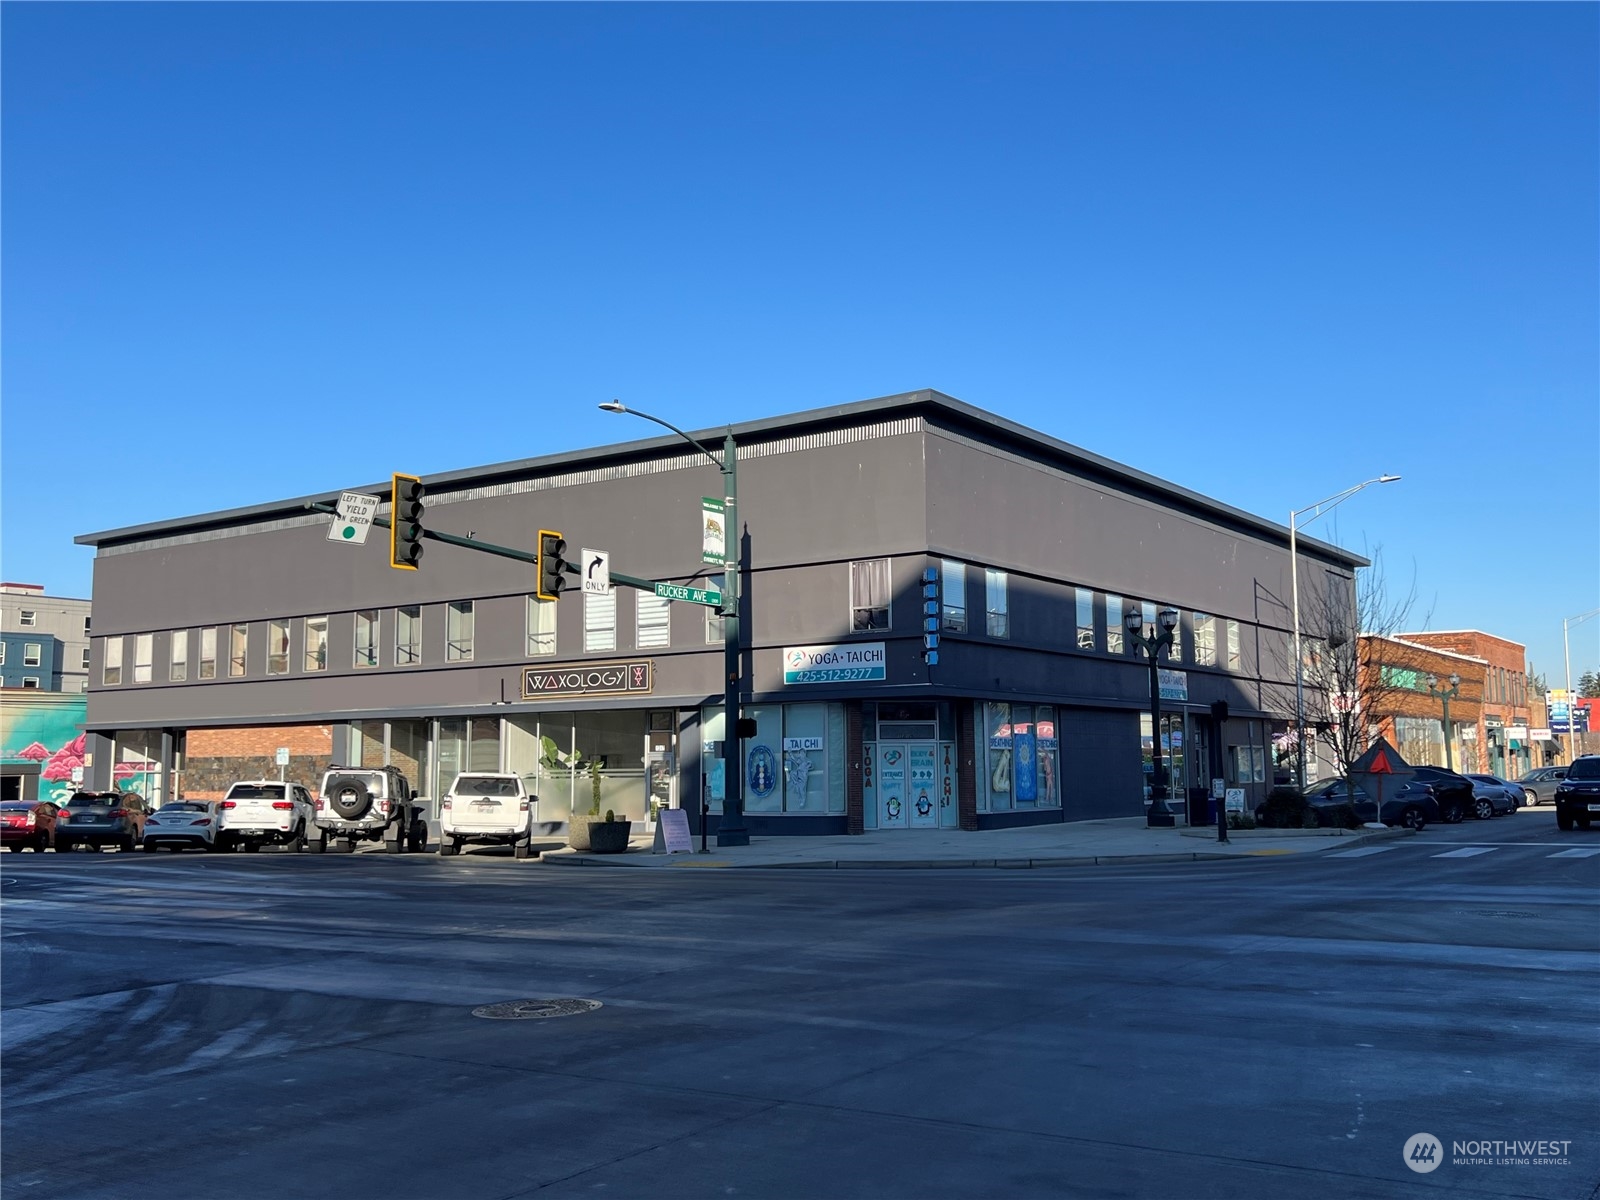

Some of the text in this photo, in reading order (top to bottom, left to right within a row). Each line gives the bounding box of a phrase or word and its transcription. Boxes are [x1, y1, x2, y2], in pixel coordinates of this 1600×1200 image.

[342, 495, 376, 506] LEFT TURN
[346, 504, 368, 516] YIELD
[349, 516, 370, 525] GREEN
[585, 581, 606, 591] ONLY
[657, 585, 689, 600] RUCKER
[692, 591, 708, 602] AVE
[808, 653, 840, 665] YOGA
[796, 668, 872, 682] 425-512-9277
[790, 739, 819, 749] TAI CHI
[990, 738, 1012, 748] BREATHING
[864, 746, 872, 788] YOGA
[911, 759, 933, 767] BRAIN
[943, 745, 951, 806] TAI CHI
